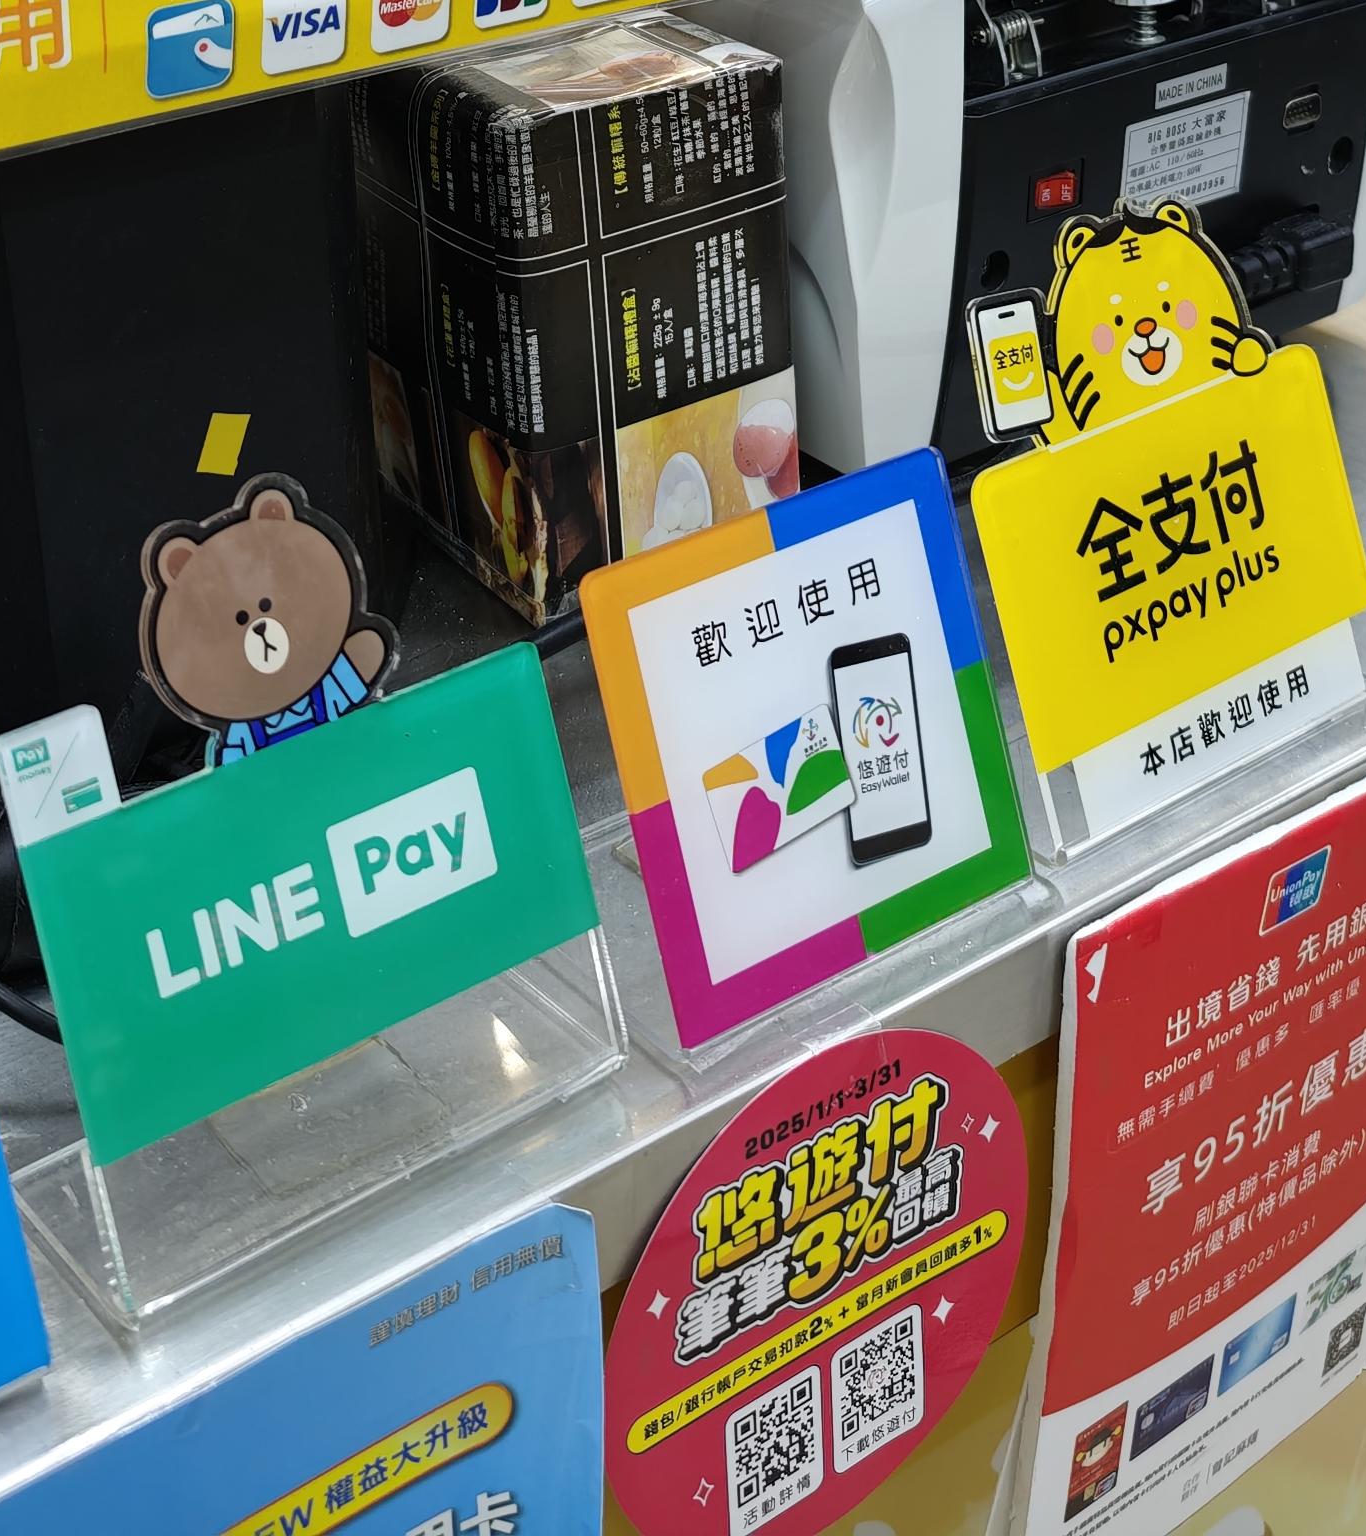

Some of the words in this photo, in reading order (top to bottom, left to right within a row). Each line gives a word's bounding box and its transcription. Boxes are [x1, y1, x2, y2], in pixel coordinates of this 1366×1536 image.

[267, 3, 341, 43] VISA
[1158, 84, 1183, 103] MADE
[1185, 81, 1194, 94] IN
[1196, 72, 1223, 91] CHINA
[1147, 129, 1162, 144] BIG
[1166, 121, 1187, 138] BOSS
[1040, 187, 1052, 202] ON
[1061, 176, 1073, 203] OFF
[993, 343, 1034, 372] 全支付
[1076, 438, 1266, 603] 全支付
[691, 557, 882, 668] 歡迎使用
[1103, 576, 1209, 663] pxpay
[1215, 544, 1281, 608] plus
[1139, 664, 1310, 777] 本店歡迎使用
[856, 749, 909, 781] 悠遊付
[145, 862, 325, 1000] LINE
[353, 811, 467, 896] Pay
[1269, 868, 1323, 904] UnionPay
[1143, 1045, 1203, 1090] Explore
[1206, 1023, 1245, 1056] More
[1247, 1001, 1280, 1028] Your
[1282, 980, 1311, 1010] Way
[1315, 956, 1344, 986] with
[1164, 955, 1282, 1049] 出境省錢
[1235, 1022, 1290, 1074] 優惠多
[696, 1077, 941, 1282] 悠遊付
[1191, 1129, 1323, 1237] 刷銀聯卡消費
[469, 1233, 566, 1293] 信用無價
[254, 1498, 315, 1536] EW
[323, 1399, 490, 1515] 權益大升級
[742, 1474, 812, 1529] 活動詳情
